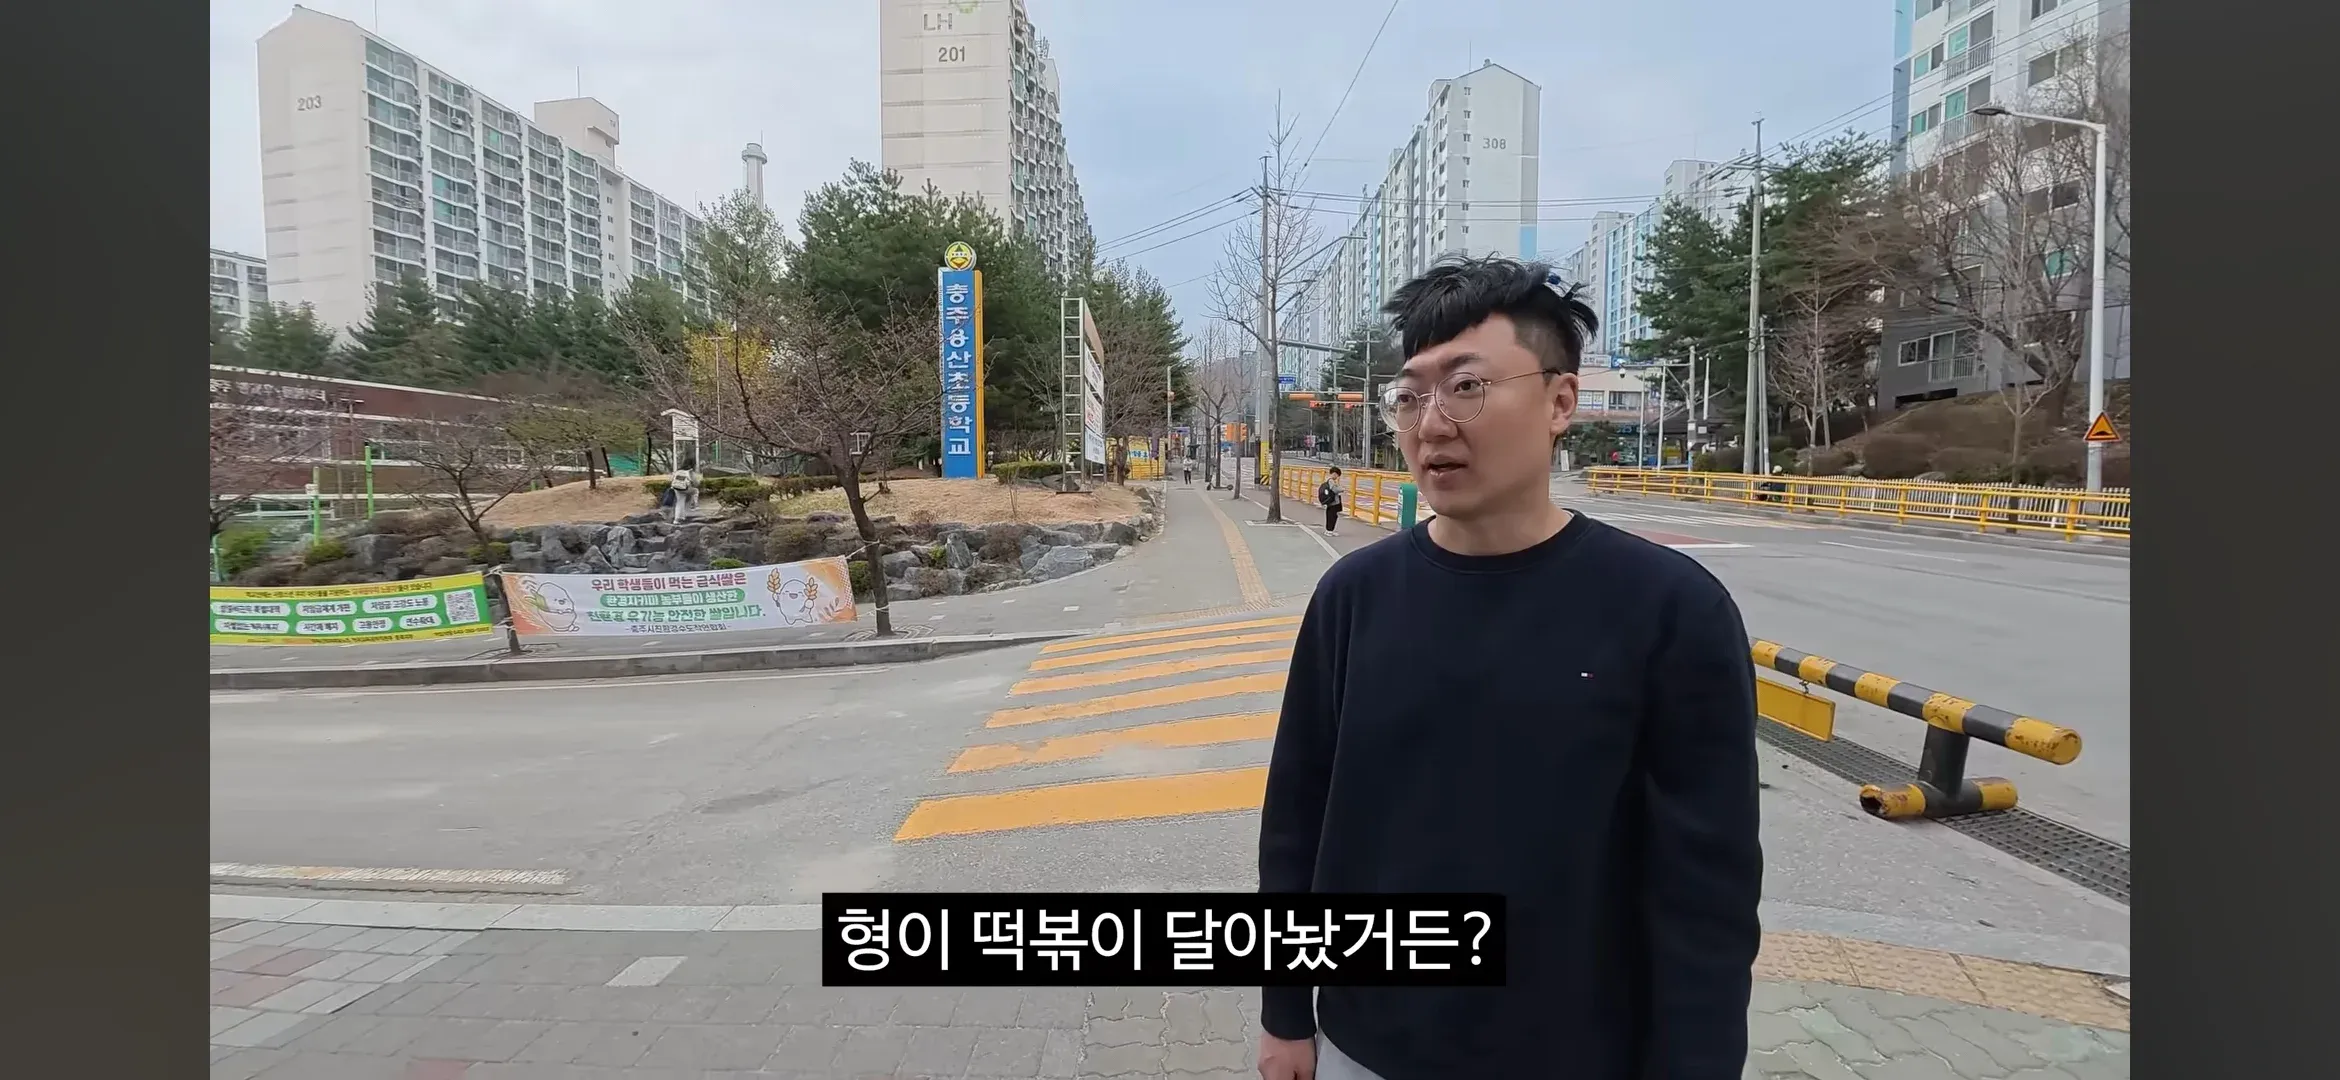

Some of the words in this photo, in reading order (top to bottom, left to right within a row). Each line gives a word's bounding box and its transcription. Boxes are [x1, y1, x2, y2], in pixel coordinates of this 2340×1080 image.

[923, 13, 953, 31] LH
[938, 46, 966, 62] 201
[297, 95, 322, 111] 203
[1482, 138, 1507, 149] 308
[945, 283, 973, 455] 충주용산초등학교
[592, 579, 615, 591] 우리
[617, 577, 666, 591] 학생들이
[669, 576, 694, 589] 먹는
[696, 572, 746, 588] 급식쌀은
[661, 592, 704, 606] 농부들이
[705, 590, 738, 604] 생산한
[586, 610, 625, 622] 친환경
[668, 608, 706, 622] 안전한
[709, 604, 766, 621] 쌀입니다.
[358, 620, 386, 629] 고용안정
